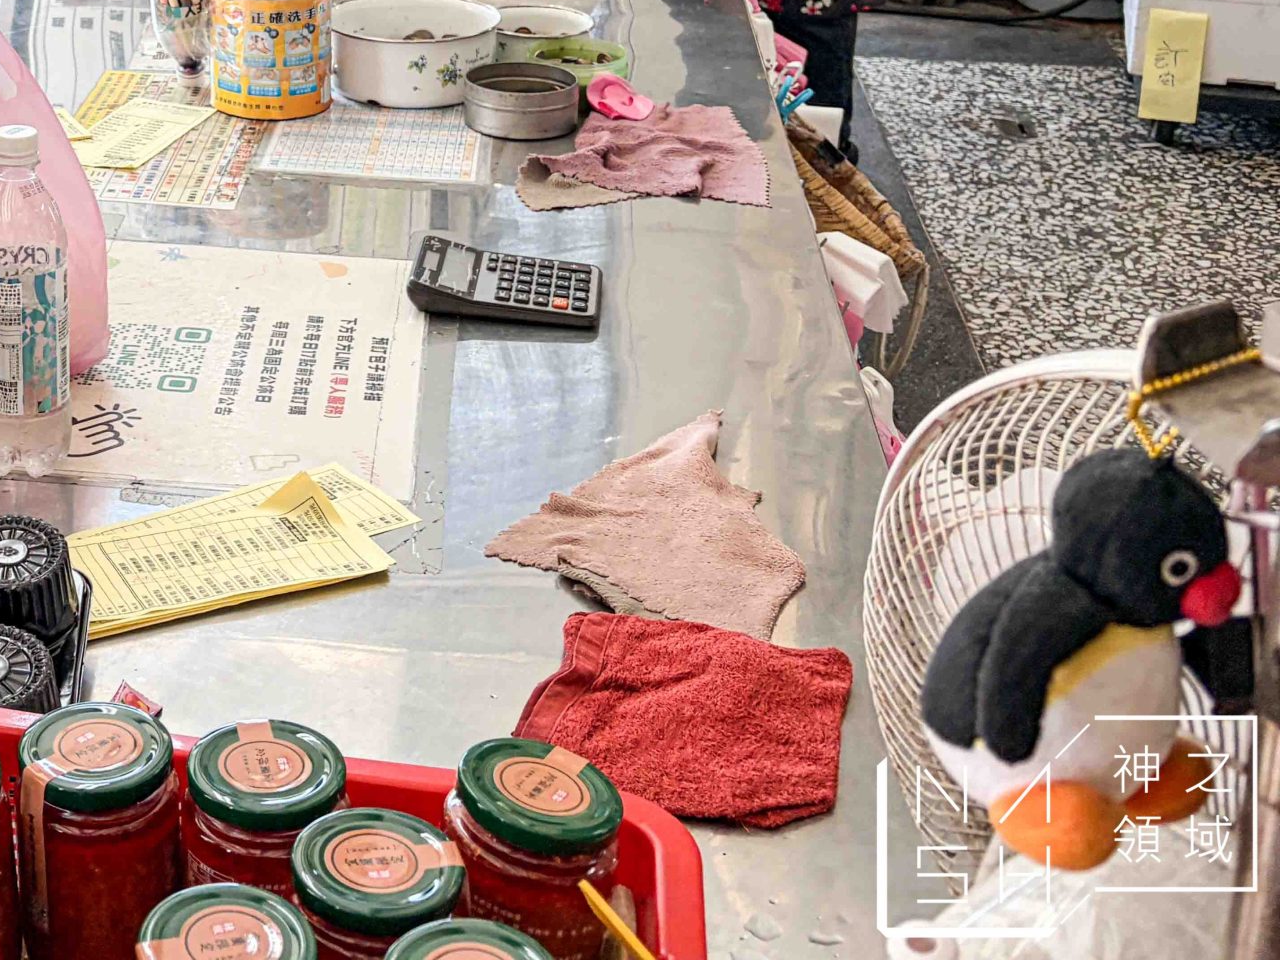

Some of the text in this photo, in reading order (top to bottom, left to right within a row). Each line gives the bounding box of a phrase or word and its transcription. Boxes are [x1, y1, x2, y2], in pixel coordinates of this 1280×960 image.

[251, 6, 317, 25] 正確洗手
[118, 343, 139, 367] LINE
[214, 305, 261, 416] 其他不定期公休會提前公告
[255, 320, 290, 403] 每周三為固定公休日
[287, 315, 325, 416] 請於每日17點前完成訂購
[363, 336, 389, 402] 預訂包子請掃描
